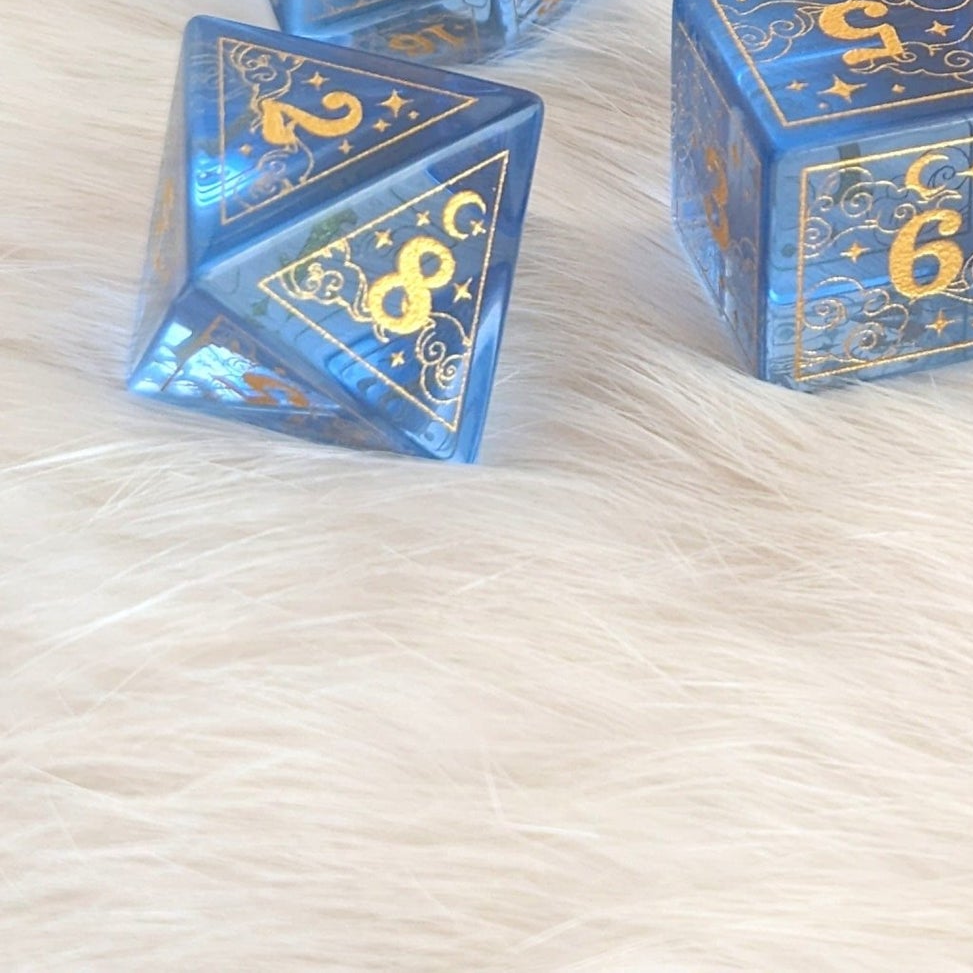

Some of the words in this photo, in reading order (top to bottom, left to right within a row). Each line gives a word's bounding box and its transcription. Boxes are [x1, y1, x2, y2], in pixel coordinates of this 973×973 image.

[818, 0, 906, 67] 5
[261, 91, 363, 146] 2
[367, 236, 456, 335] 8
[888, 209, 965, 298] 6
